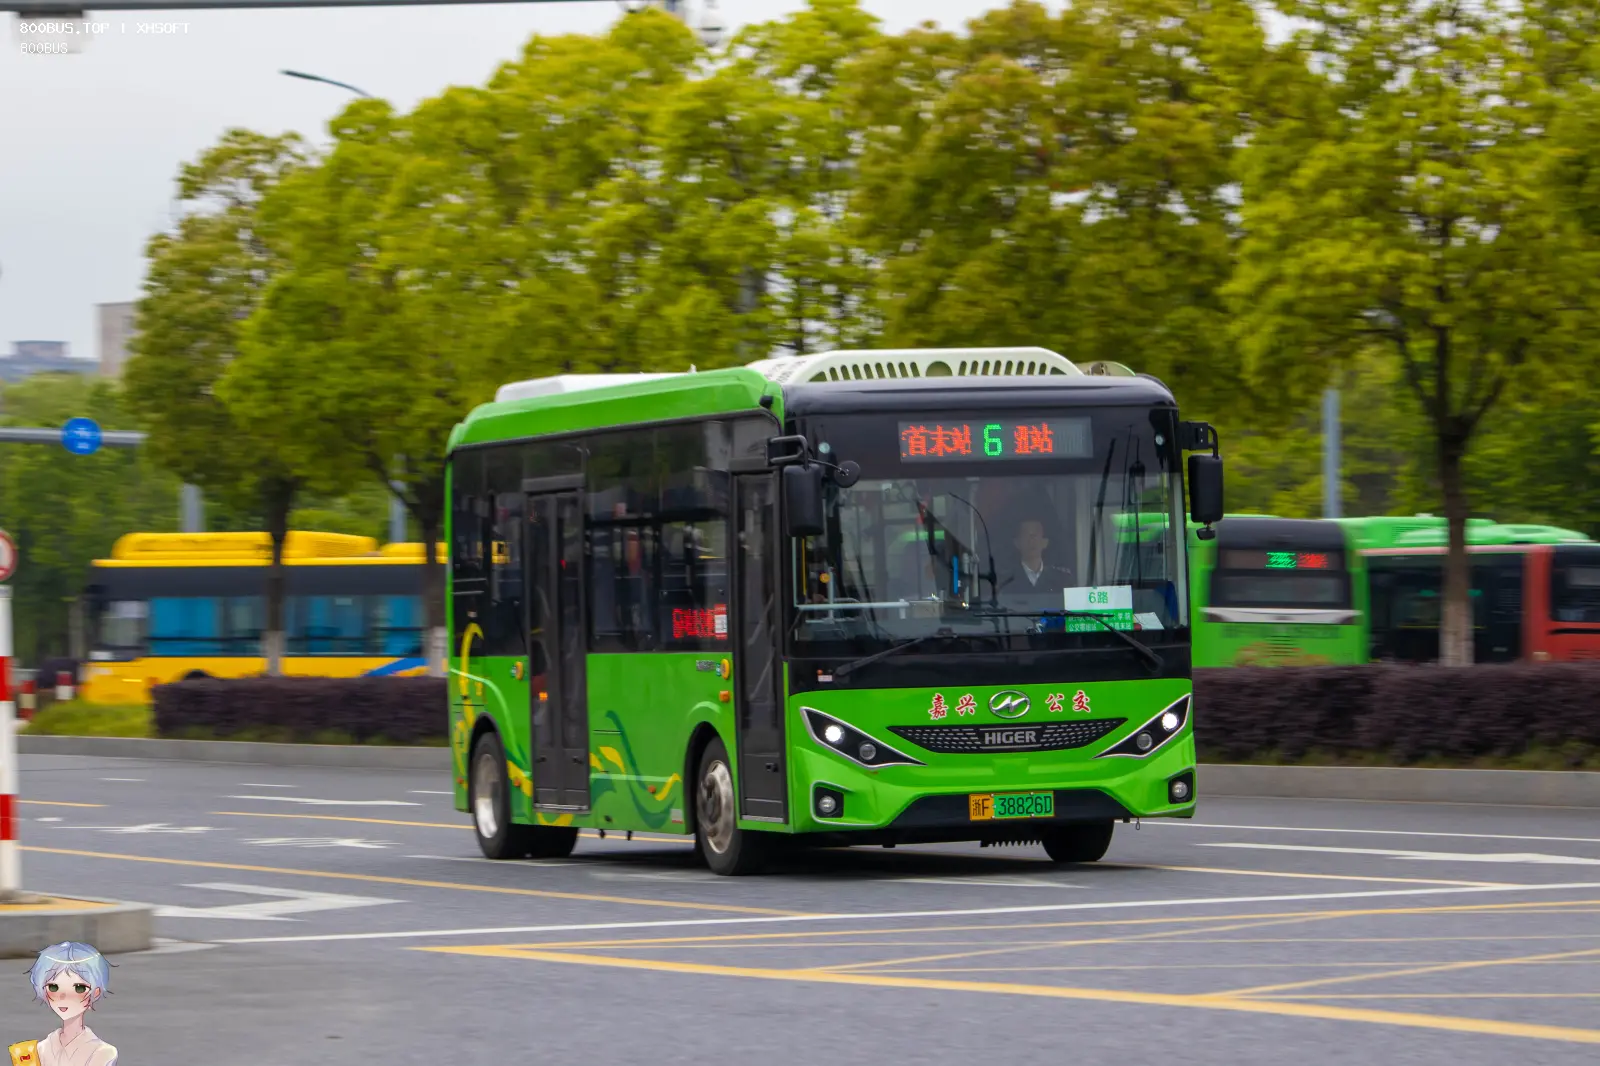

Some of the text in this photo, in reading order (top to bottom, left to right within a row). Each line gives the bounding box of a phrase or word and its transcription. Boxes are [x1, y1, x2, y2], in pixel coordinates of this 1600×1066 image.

[903, 424, 972, 457] 首末站
[983, 424, 1003, 456] 6
[1088, 591, 1109, 604] 6路
[928, 690, 1091, 720] 嘉兴 公交
[984, 730, 1037, 745] HIGER
